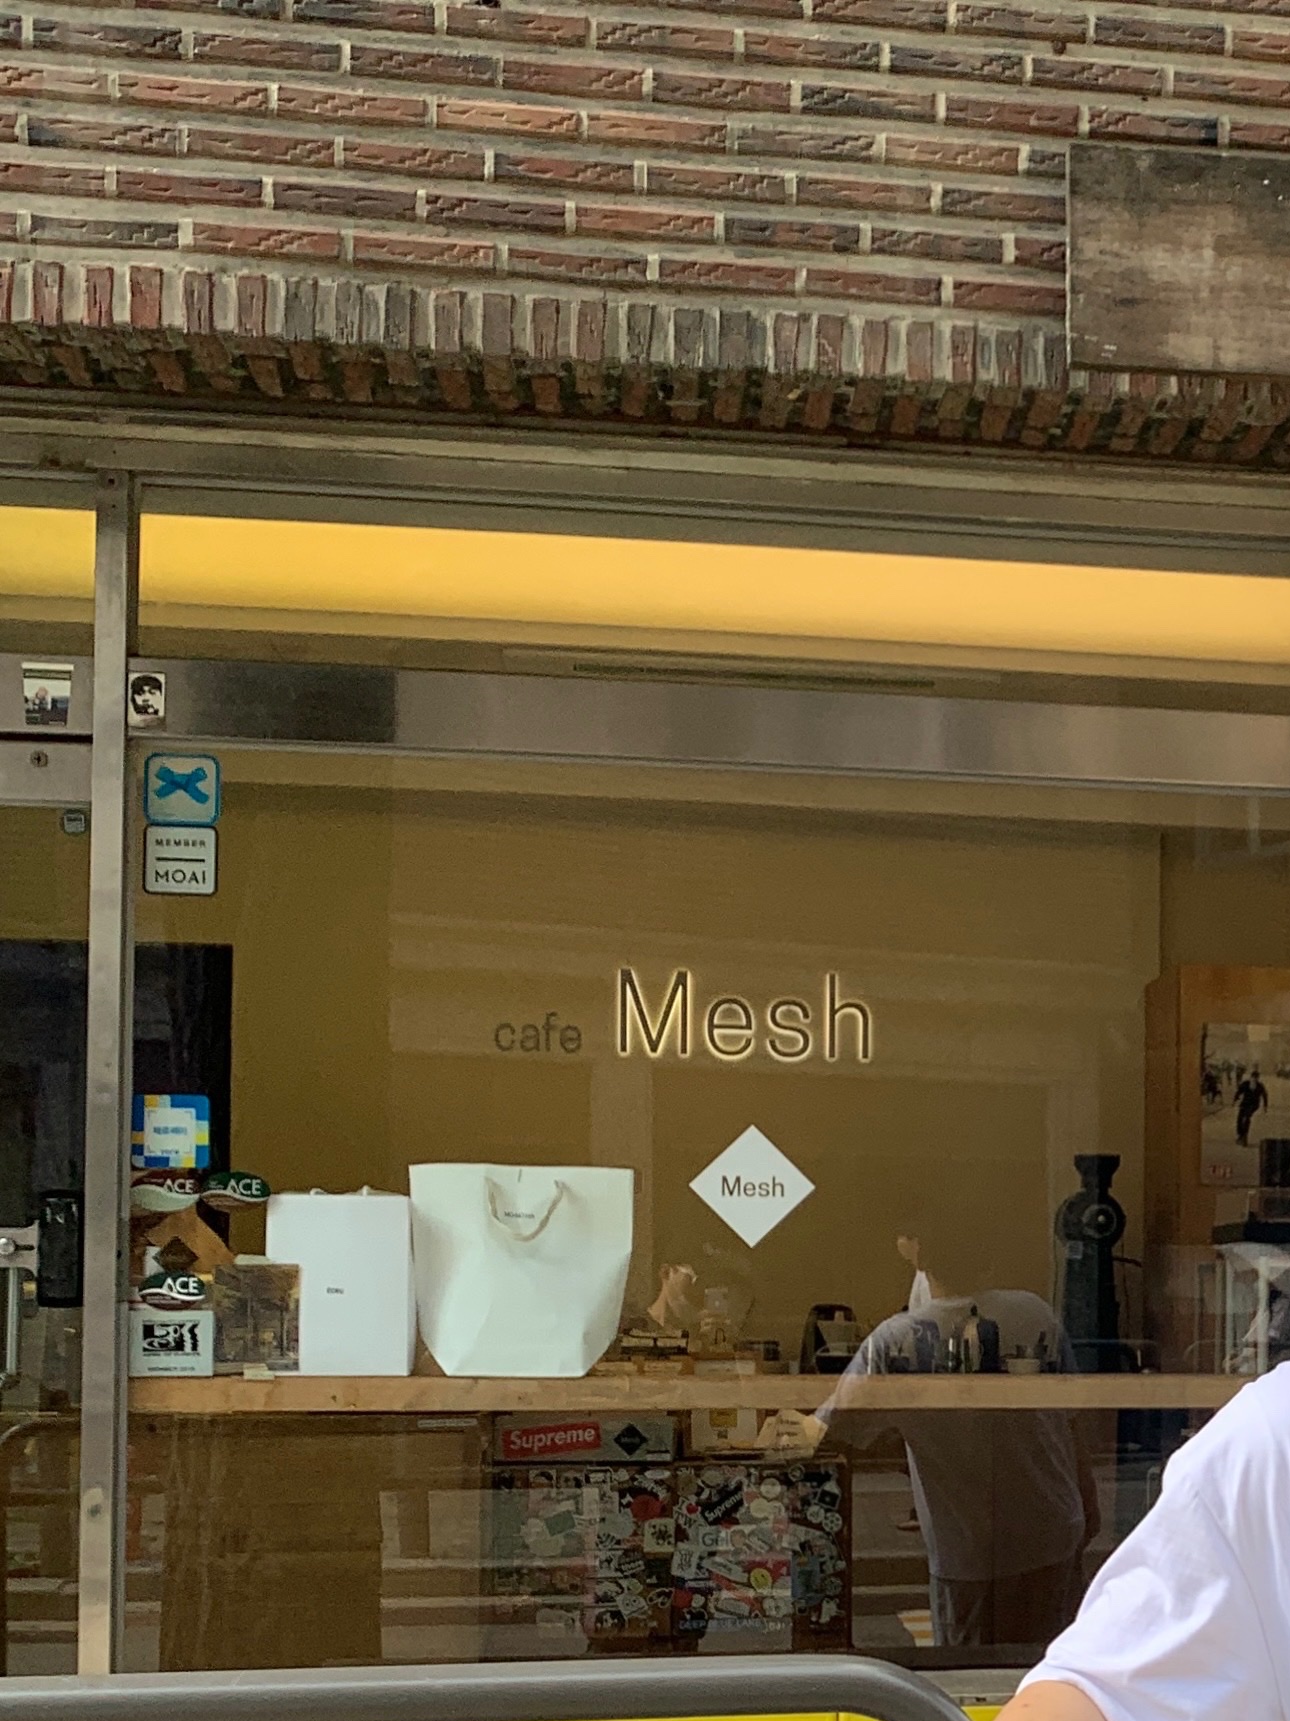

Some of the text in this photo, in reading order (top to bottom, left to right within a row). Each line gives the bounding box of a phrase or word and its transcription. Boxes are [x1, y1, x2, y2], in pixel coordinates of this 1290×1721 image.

[155, 838, 206, 848] MEMBER
[155, 870, 206, 885] MOAI
[494, 968, 872, 1063] cafe Mesh
[163, 1178, 195, 1193] ACE
[226, 1178, 261, 1194] ACE
[721, 1175, 785, 1199] Mesh
[161, 1277, 199, 1294] ACE
[510, 1427, 596, 1451] Supreme
